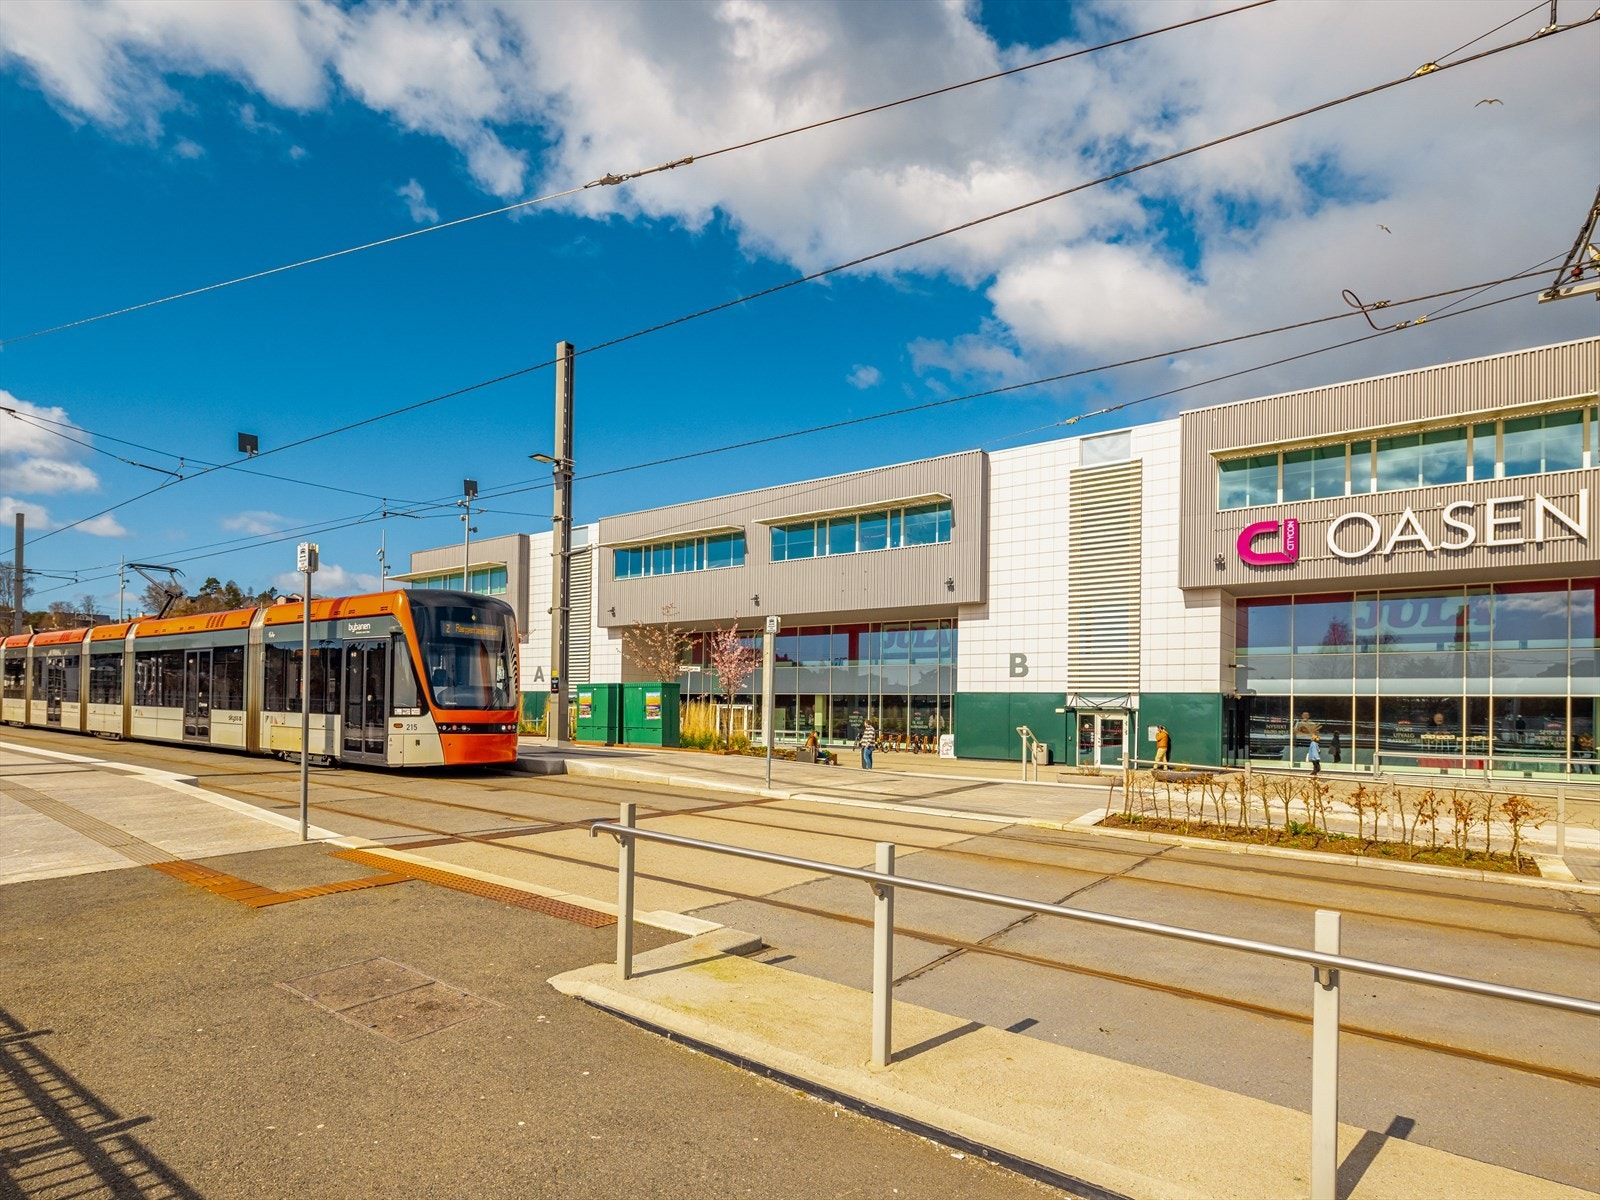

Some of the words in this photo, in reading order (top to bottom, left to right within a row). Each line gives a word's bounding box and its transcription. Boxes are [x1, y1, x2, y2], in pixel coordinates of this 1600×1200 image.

[1327, 489, 1588, 558] OASEN
[348, 623, 371, 633] bybanen
[445, 624, 451, 633] 2
[1010, 653, 1029, 677] B
[534, 666, 544, 682] A
